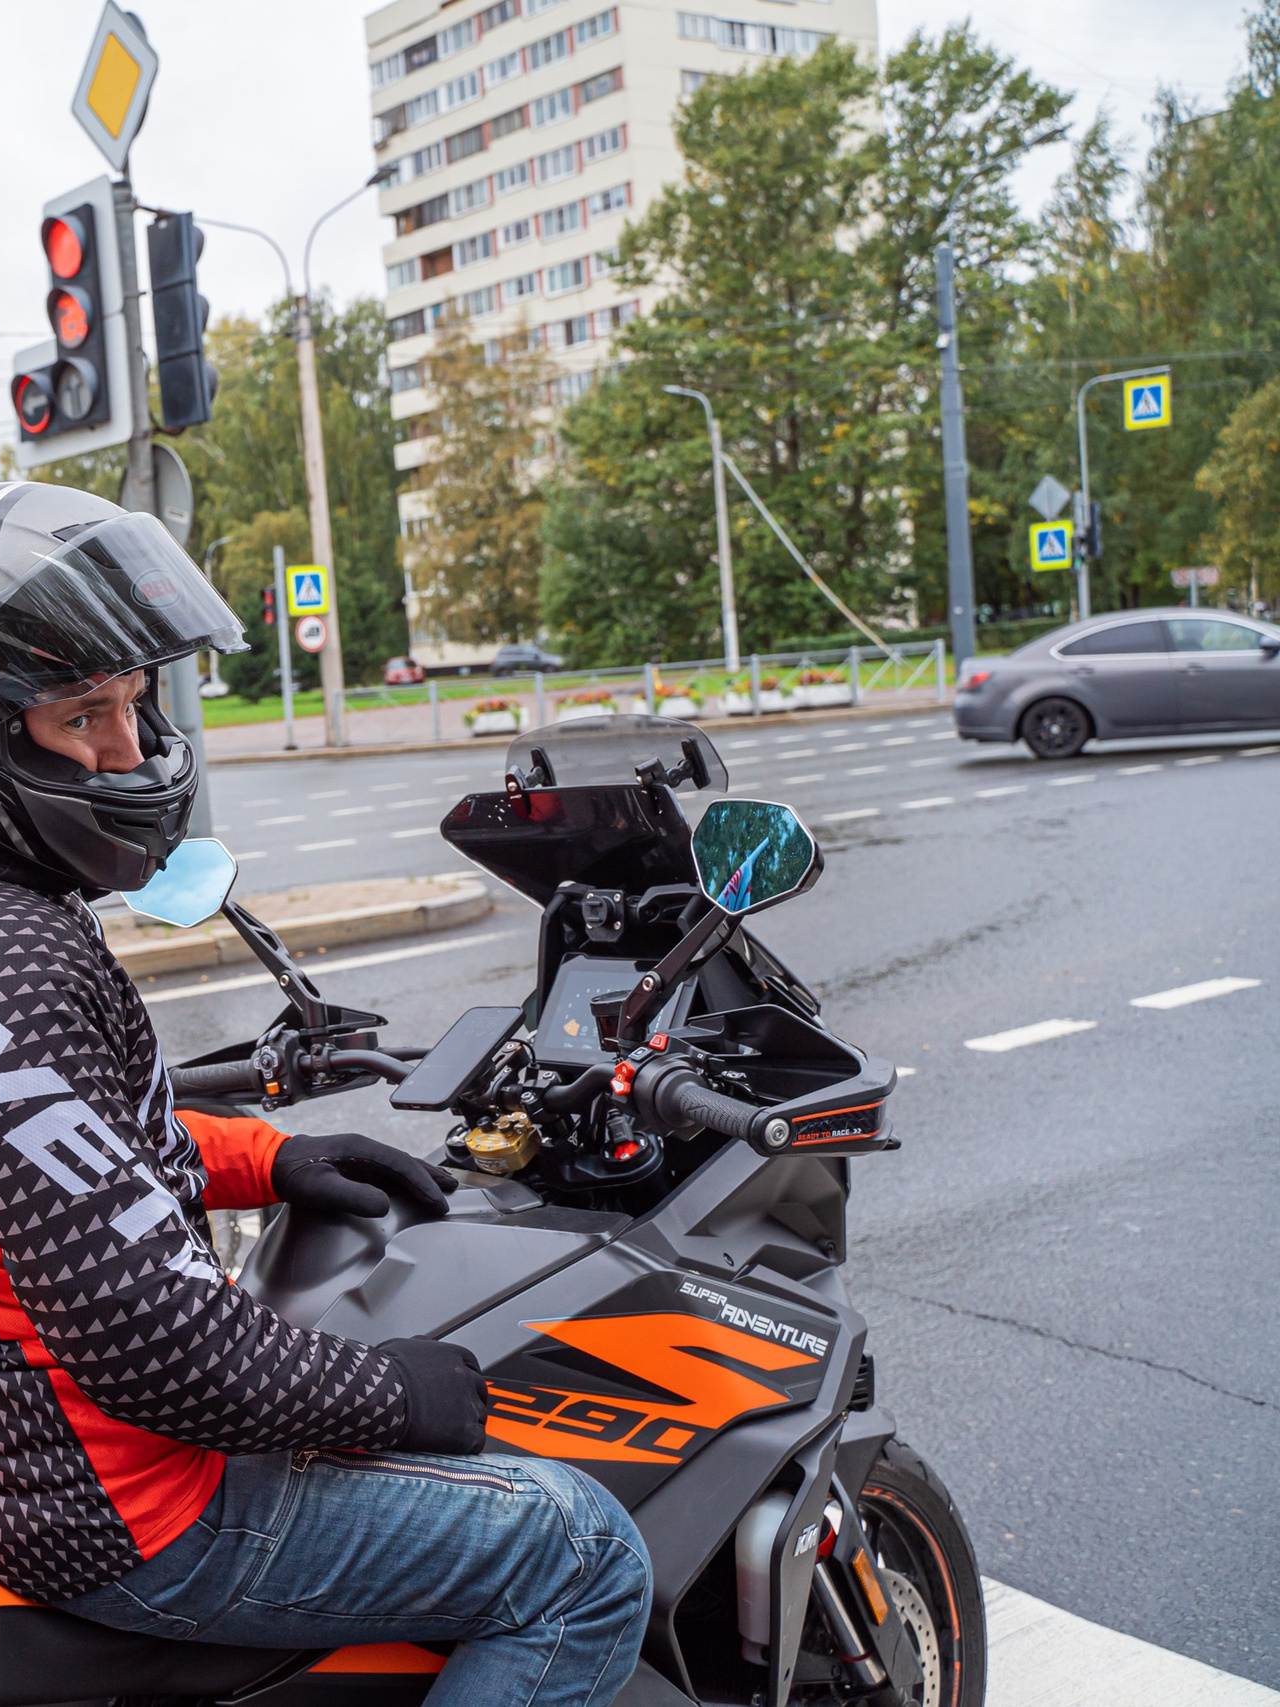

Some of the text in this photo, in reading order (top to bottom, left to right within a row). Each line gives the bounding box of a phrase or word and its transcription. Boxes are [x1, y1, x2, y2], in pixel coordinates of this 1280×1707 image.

[797, 1128, 850, 1141] READY TO RACE
[679, 1281, 728, 1306] SUPER
[720, 1303, 829, 1357] ADVENTURE
[793, 1523, 820, 1557] KTM
